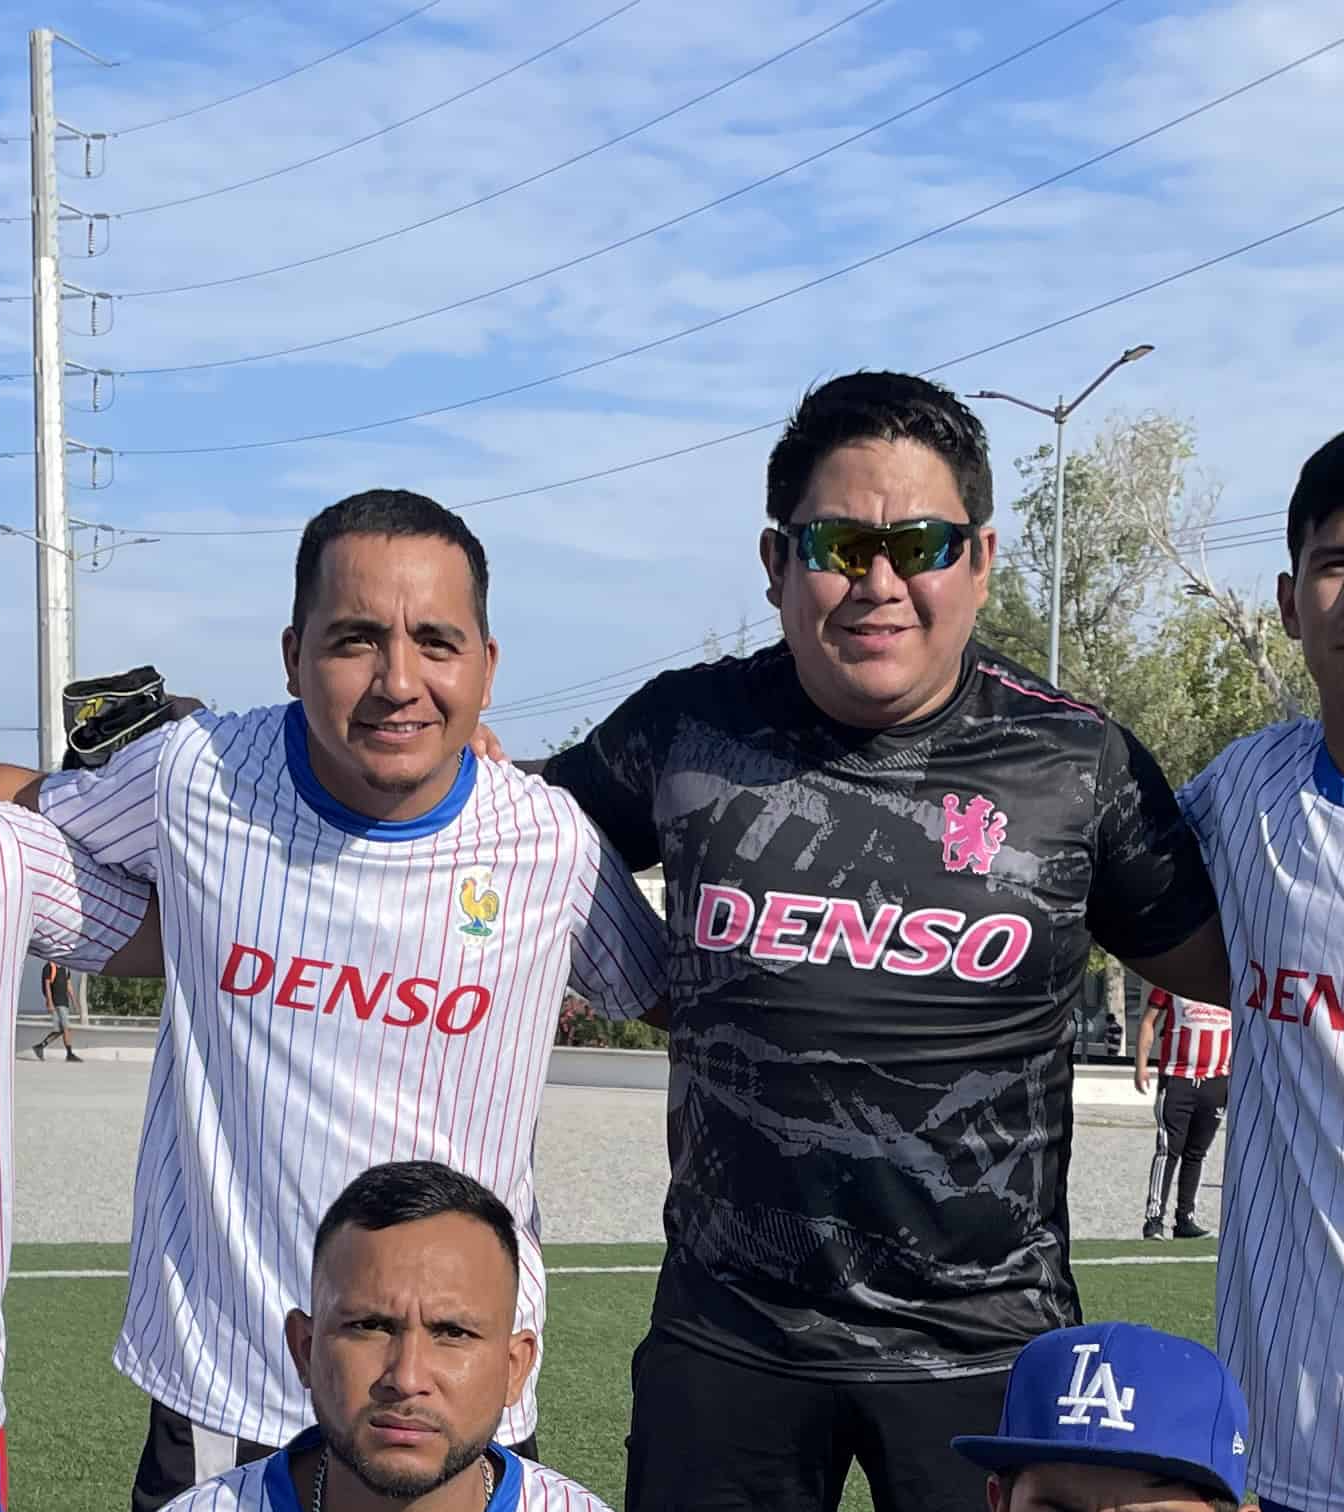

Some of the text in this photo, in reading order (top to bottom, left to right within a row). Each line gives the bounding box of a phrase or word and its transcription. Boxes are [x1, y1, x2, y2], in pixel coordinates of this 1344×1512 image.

[695, 884, 1032, 982] DENSO
[222, 944, 491, 1036] DENSO
[1057, 1343, 1135, 1432] LA
